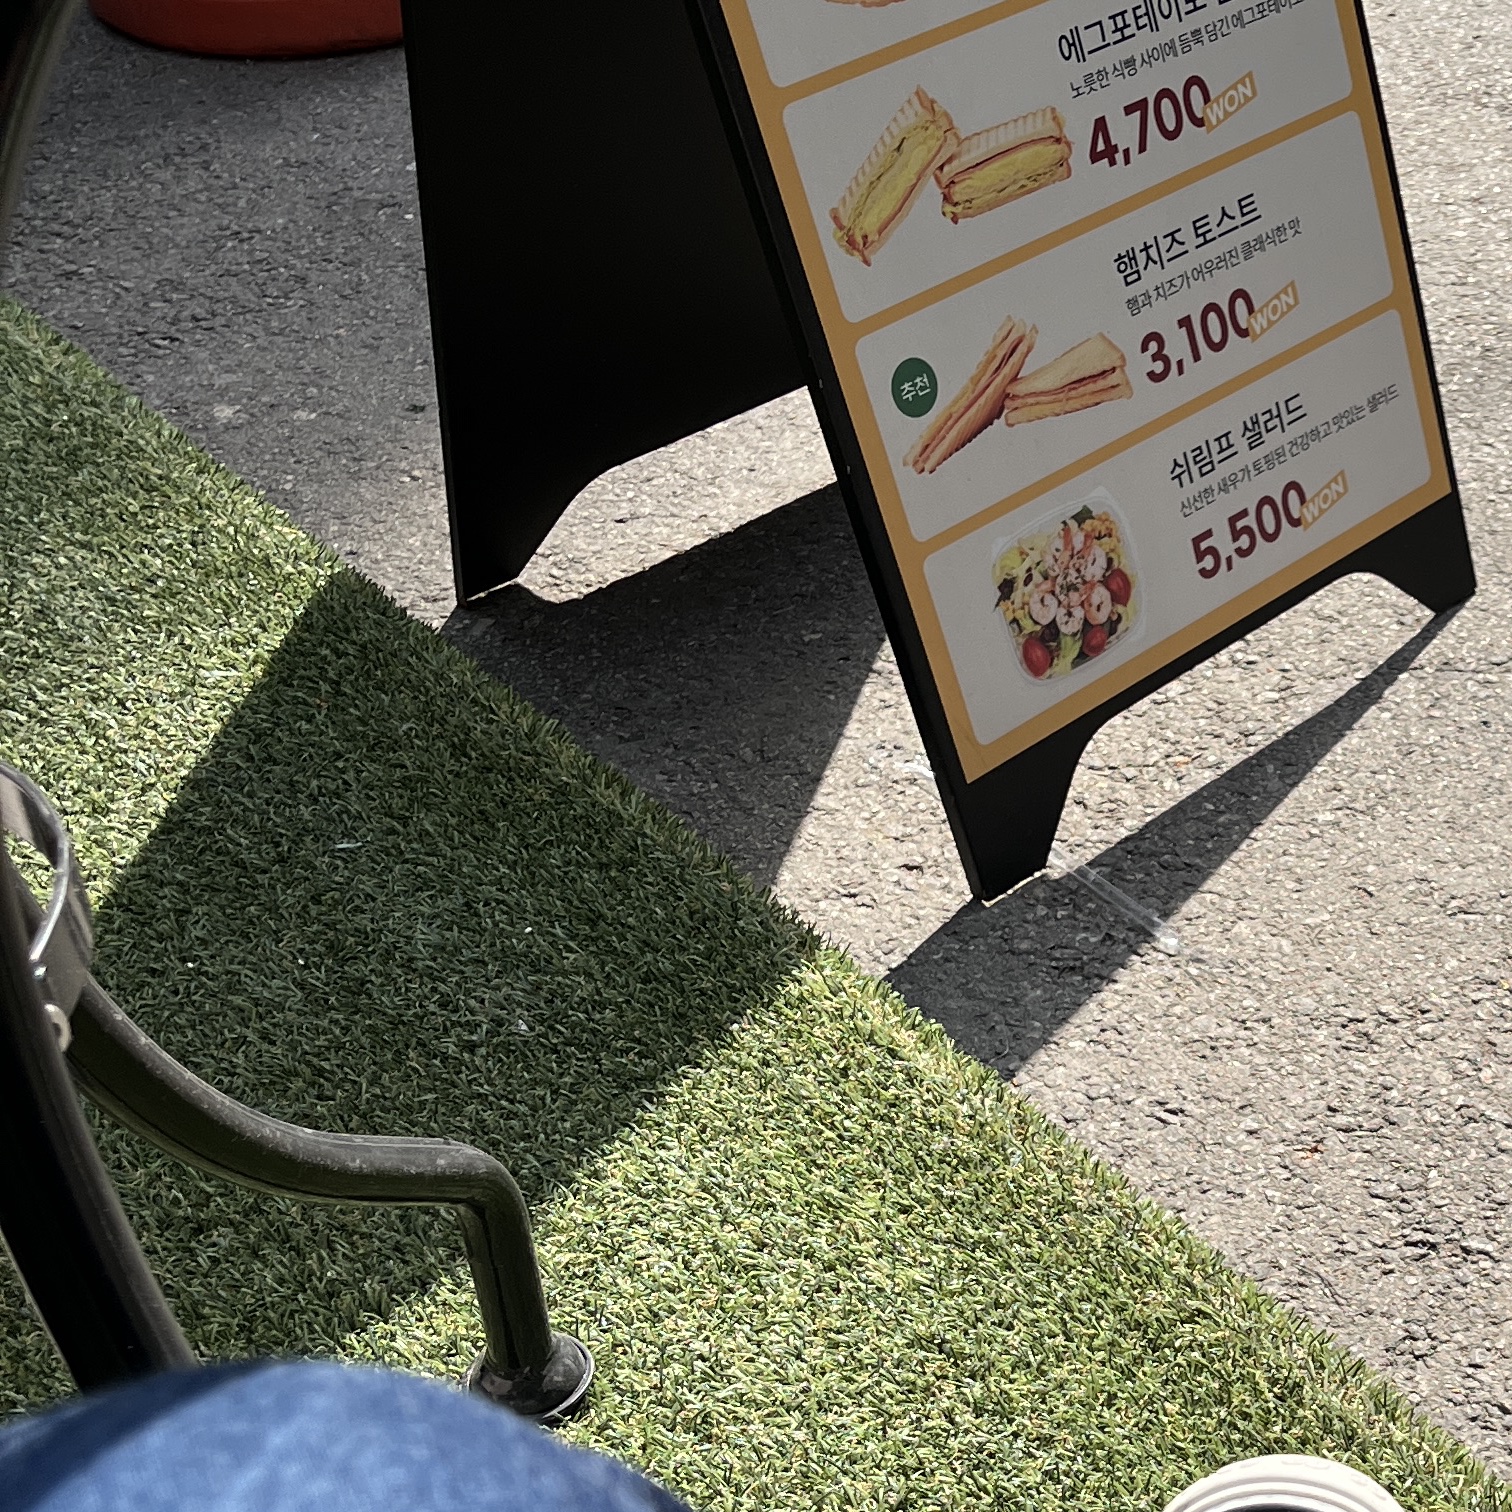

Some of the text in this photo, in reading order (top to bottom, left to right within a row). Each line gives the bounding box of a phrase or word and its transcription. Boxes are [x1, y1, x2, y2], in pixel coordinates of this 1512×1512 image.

[1069, 0, 1304, 99] 노릇한 식빵 사이에 듬뿍 담긴 에그포테이
[1089, 75, 1254, 168] 4,700 WON
[1113, 193, 1262, 287] 햄치즈 토스트
[1125, 216, 1302, 317] 햄과 치즈가 어우러진 클래식한 맛
[1140, 286, 1296, 383] 3,100 WON
[900, 373, 931, 402] 추천
[1169, 393, 1308, 489] 쉬림프 샐러드
[1179, 383, 1400, 518] 신선한 새우가 토핑된 건강하고 맛있는 샐러드
[1190, 474, 1345, 579] 5,500 WON
